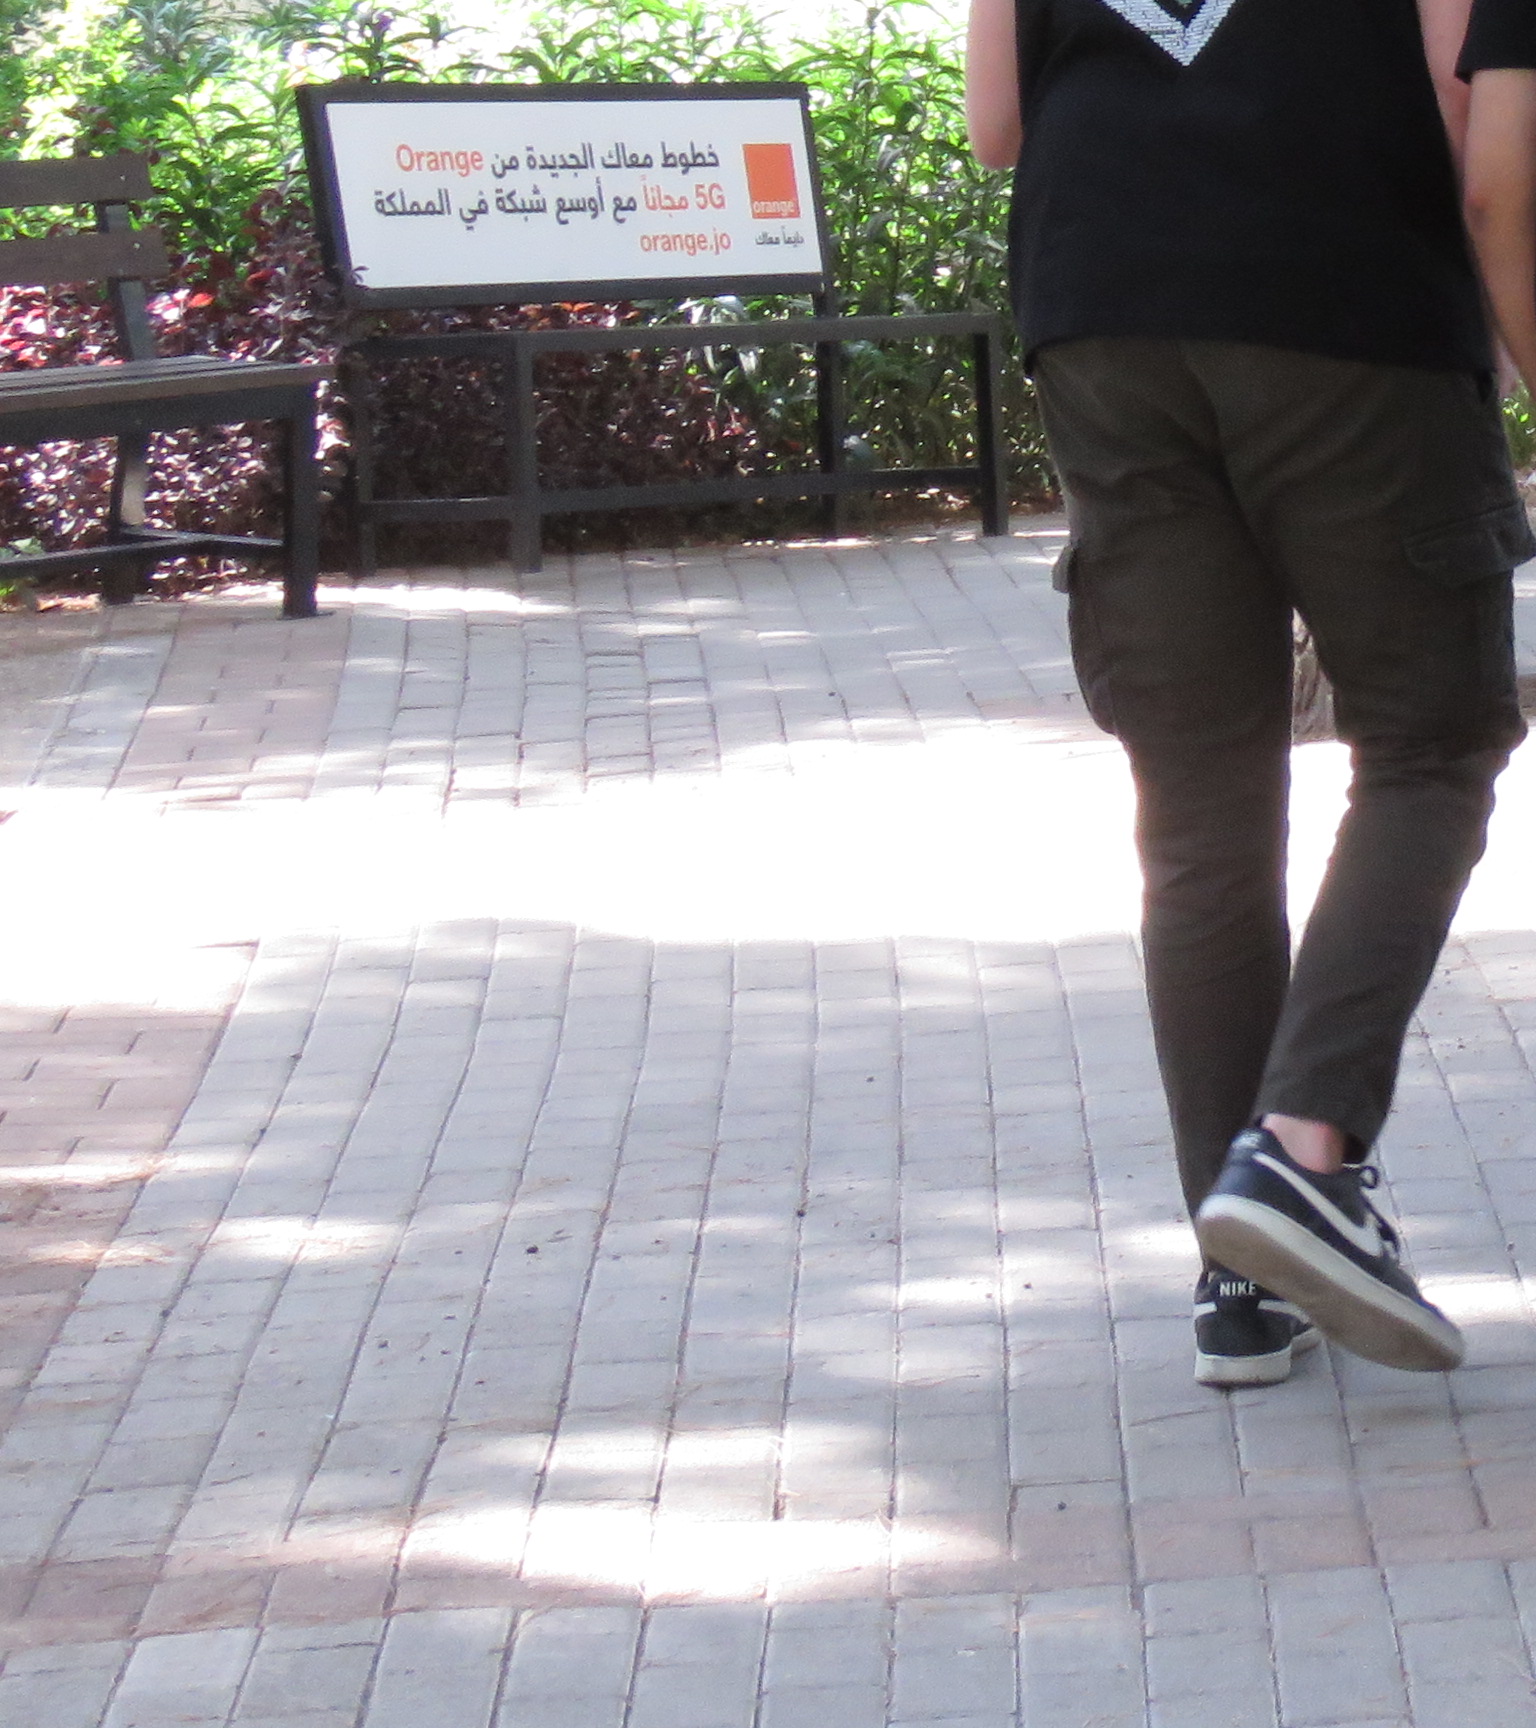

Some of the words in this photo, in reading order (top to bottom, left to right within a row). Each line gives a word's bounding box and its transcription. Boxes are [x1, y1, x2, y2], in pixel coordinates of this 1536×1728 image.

[396, 143, 484, 177] Orange
[490, 153, 520, 179] من
[525, 145, 595, 178] الجديدة
[601, 142, 653, 169] معاك
[661, 141, 719, 175] خطوط
[374, 188, 451, 216] المملكة
[495, 184, 547, 222] شبكة
[556, 176, 604, 225] أوسع
[612, 195, 637, 223] مع
[694, 182, 726, 210] 5G
[753, 201, 795, 217] orange
[459, 190, 489, 231] في
[640, 227, 731, 256] orange.jo
[1220, 1281, 1257, 1297] NIKE
